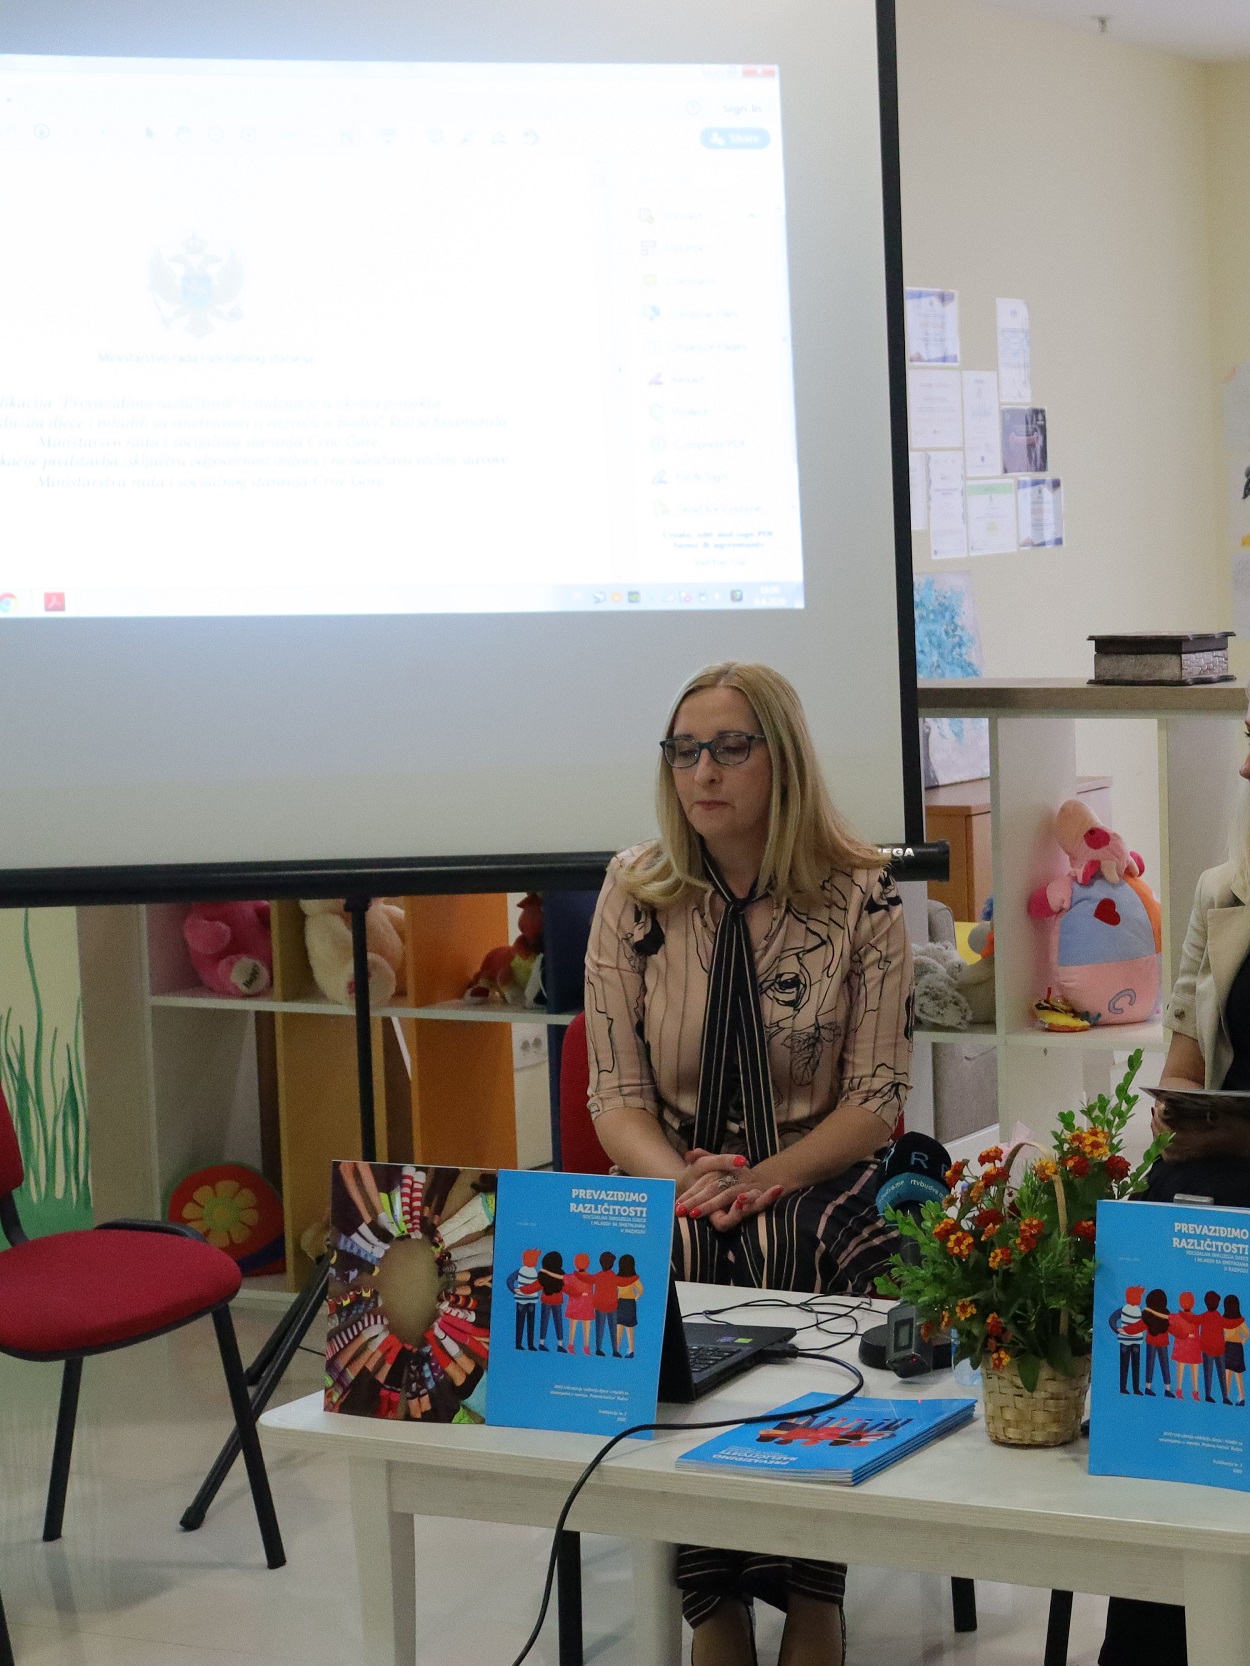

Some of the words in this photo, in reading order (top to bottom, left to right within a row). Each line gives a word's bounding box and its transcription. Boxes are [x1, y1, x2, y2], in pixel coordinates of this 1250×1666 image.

[910, 1151, 929, 1169] R
[572, 1188, 648, 1203] PREVAZIĐIMO
[570, 1203, 647, 1217] RAZLIČITOSTI
[1174, 1222, 1249, 1240] PREVAZIĐIMO
[1172, 1238, 1248, 1254] RAZLIČITOSTI
